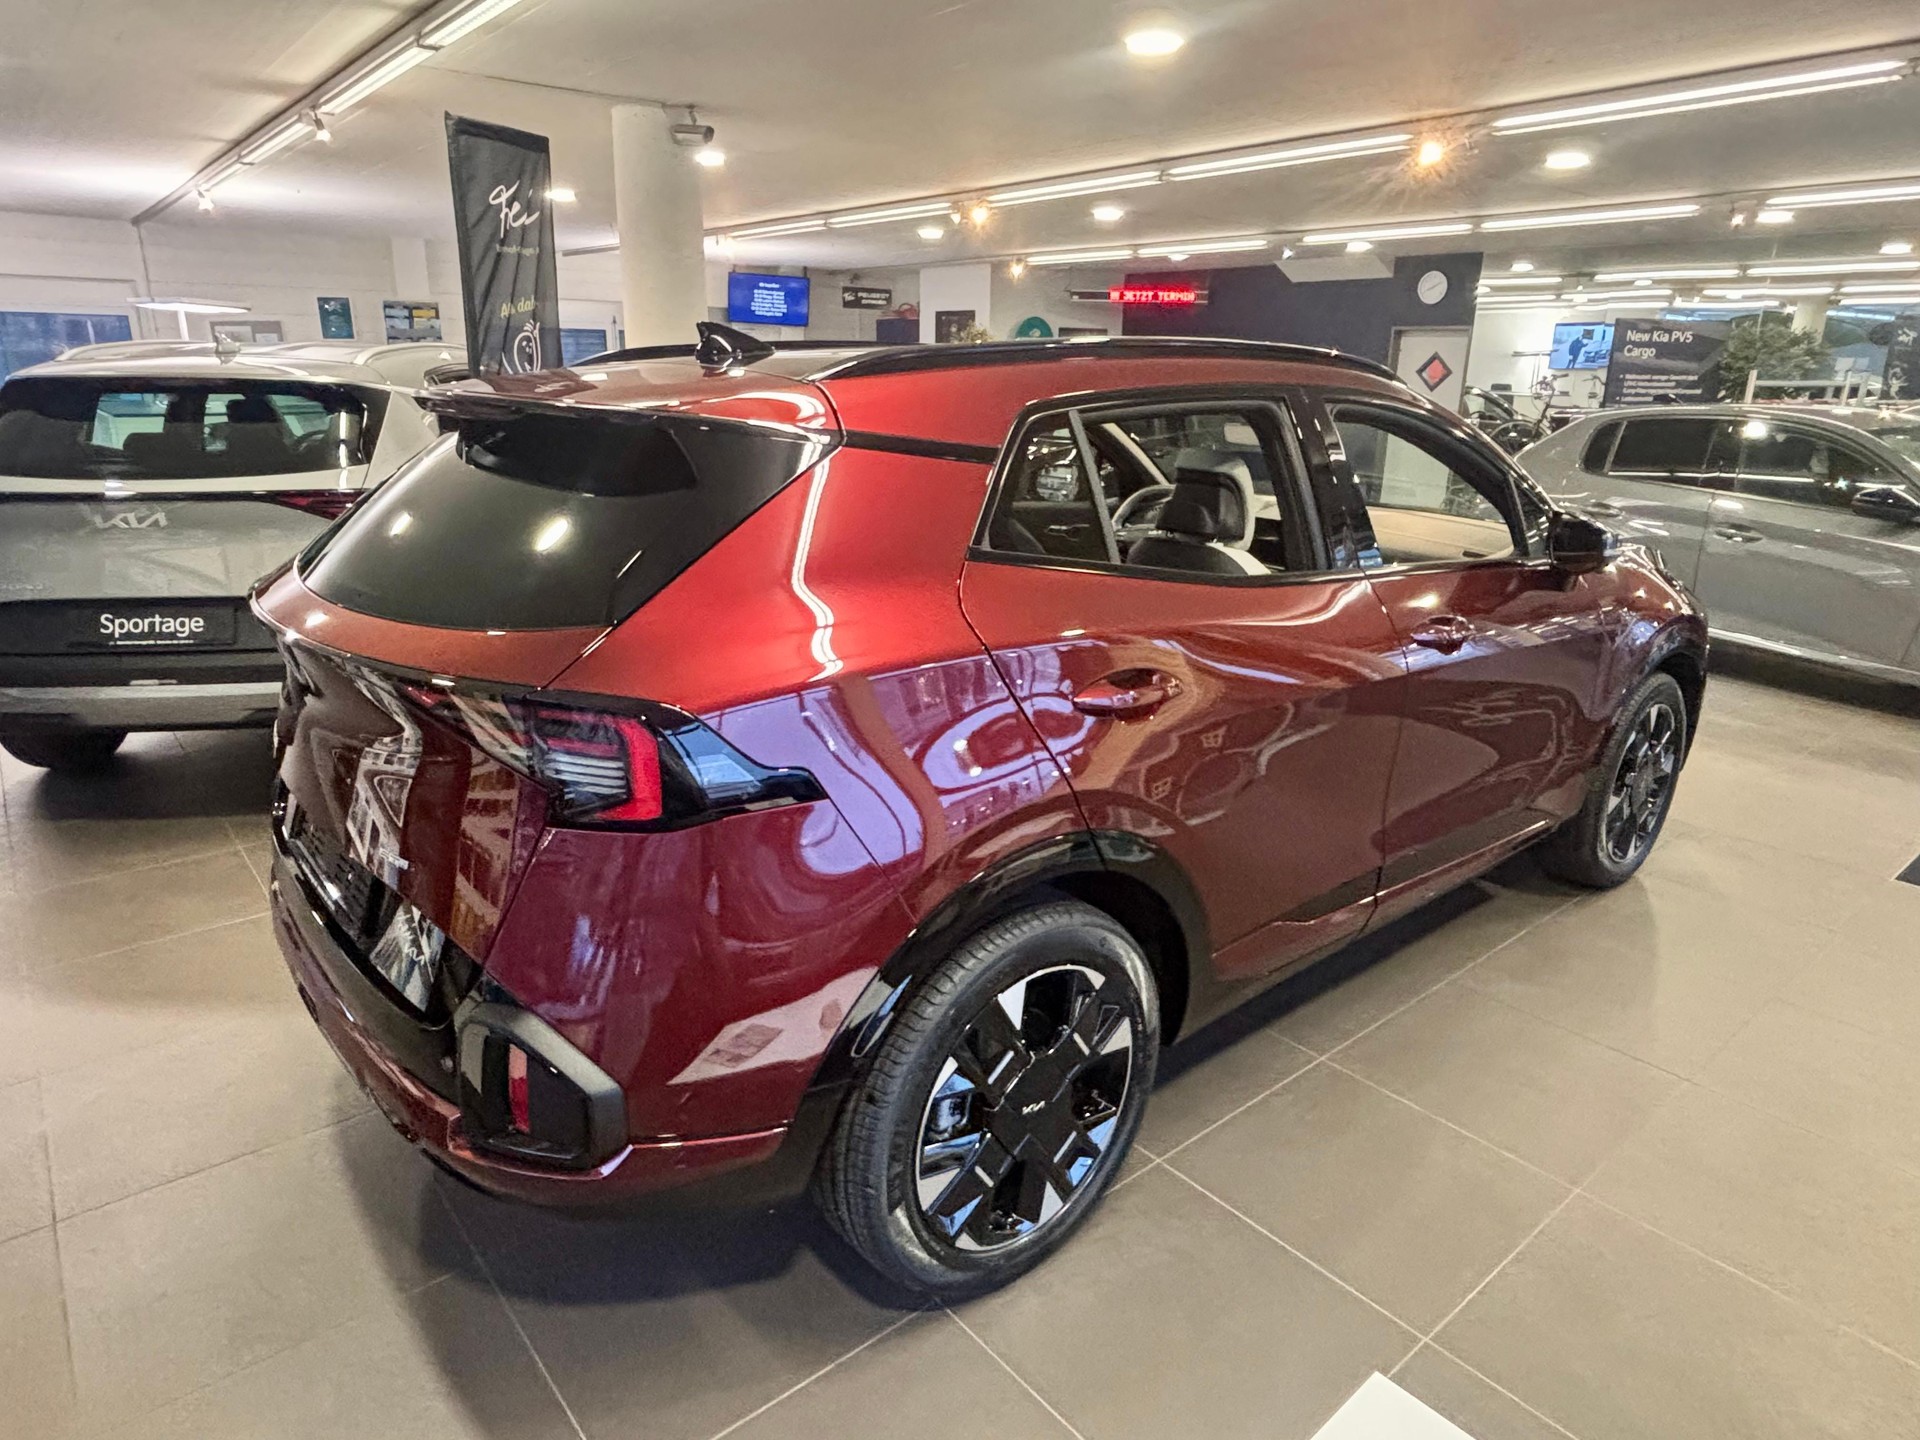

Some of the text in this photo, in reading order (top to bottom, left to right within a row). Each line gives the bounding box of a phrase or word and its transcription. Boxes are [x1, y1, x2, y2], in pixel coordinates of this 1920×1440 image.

[1123, 290, 1154, 301] JETZT
[1626, 329, 1693, 343] New Kia PV5
[1624, 344, 1656, 359] Cargo
[100, 613, 204, 638] Sportage
